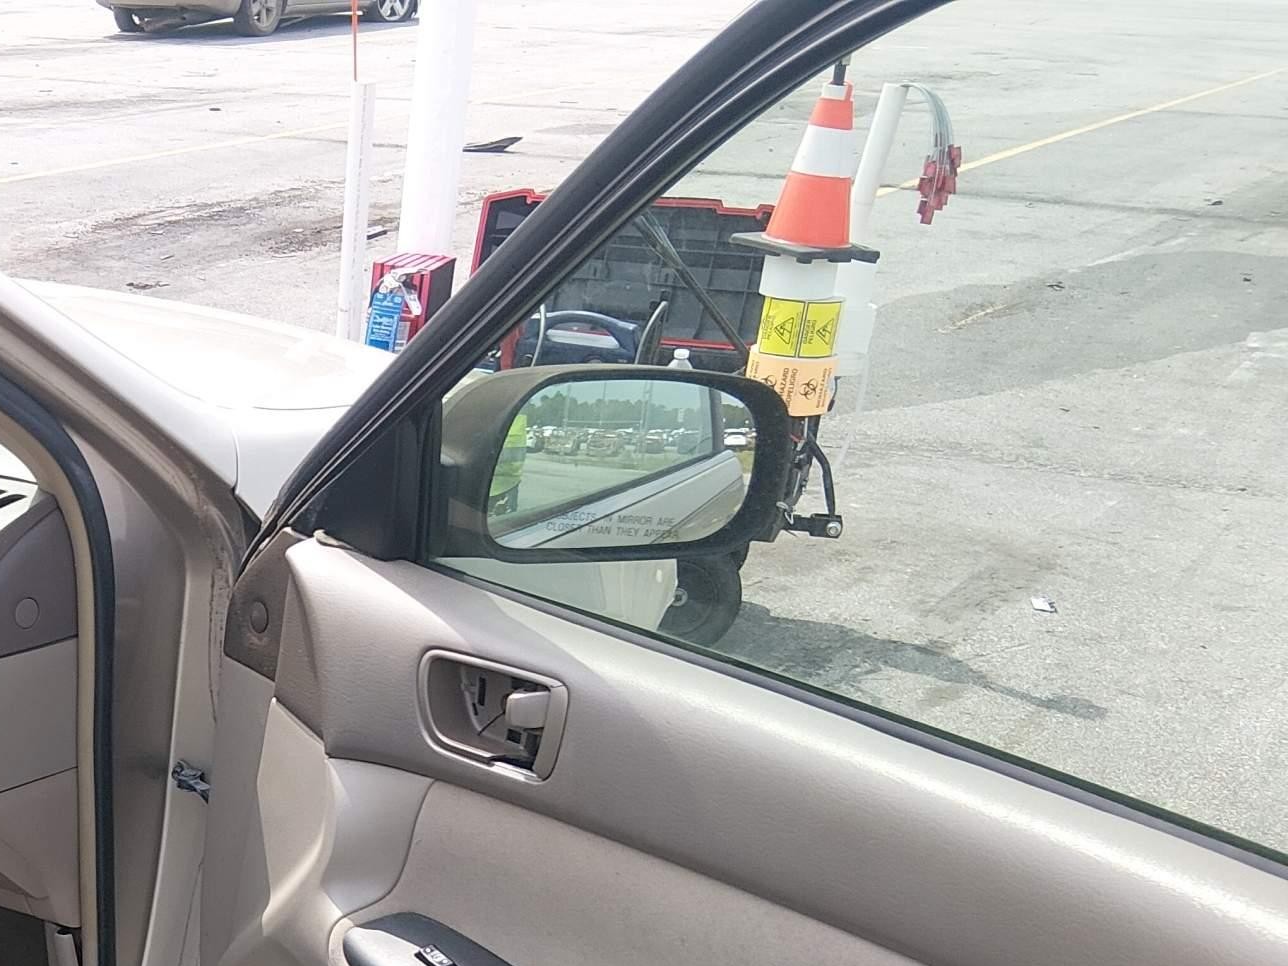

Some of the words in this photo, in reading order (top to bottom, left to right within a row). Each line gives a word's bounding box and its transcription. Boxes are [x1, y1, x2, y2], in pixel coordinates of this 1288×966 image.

[779, 367, 790, 394] HAZARD
[557, 511, 597, 521] BJECTS
[617, 515, 652, 525] MIRROR
[616, 526, 640, 536] THEY
